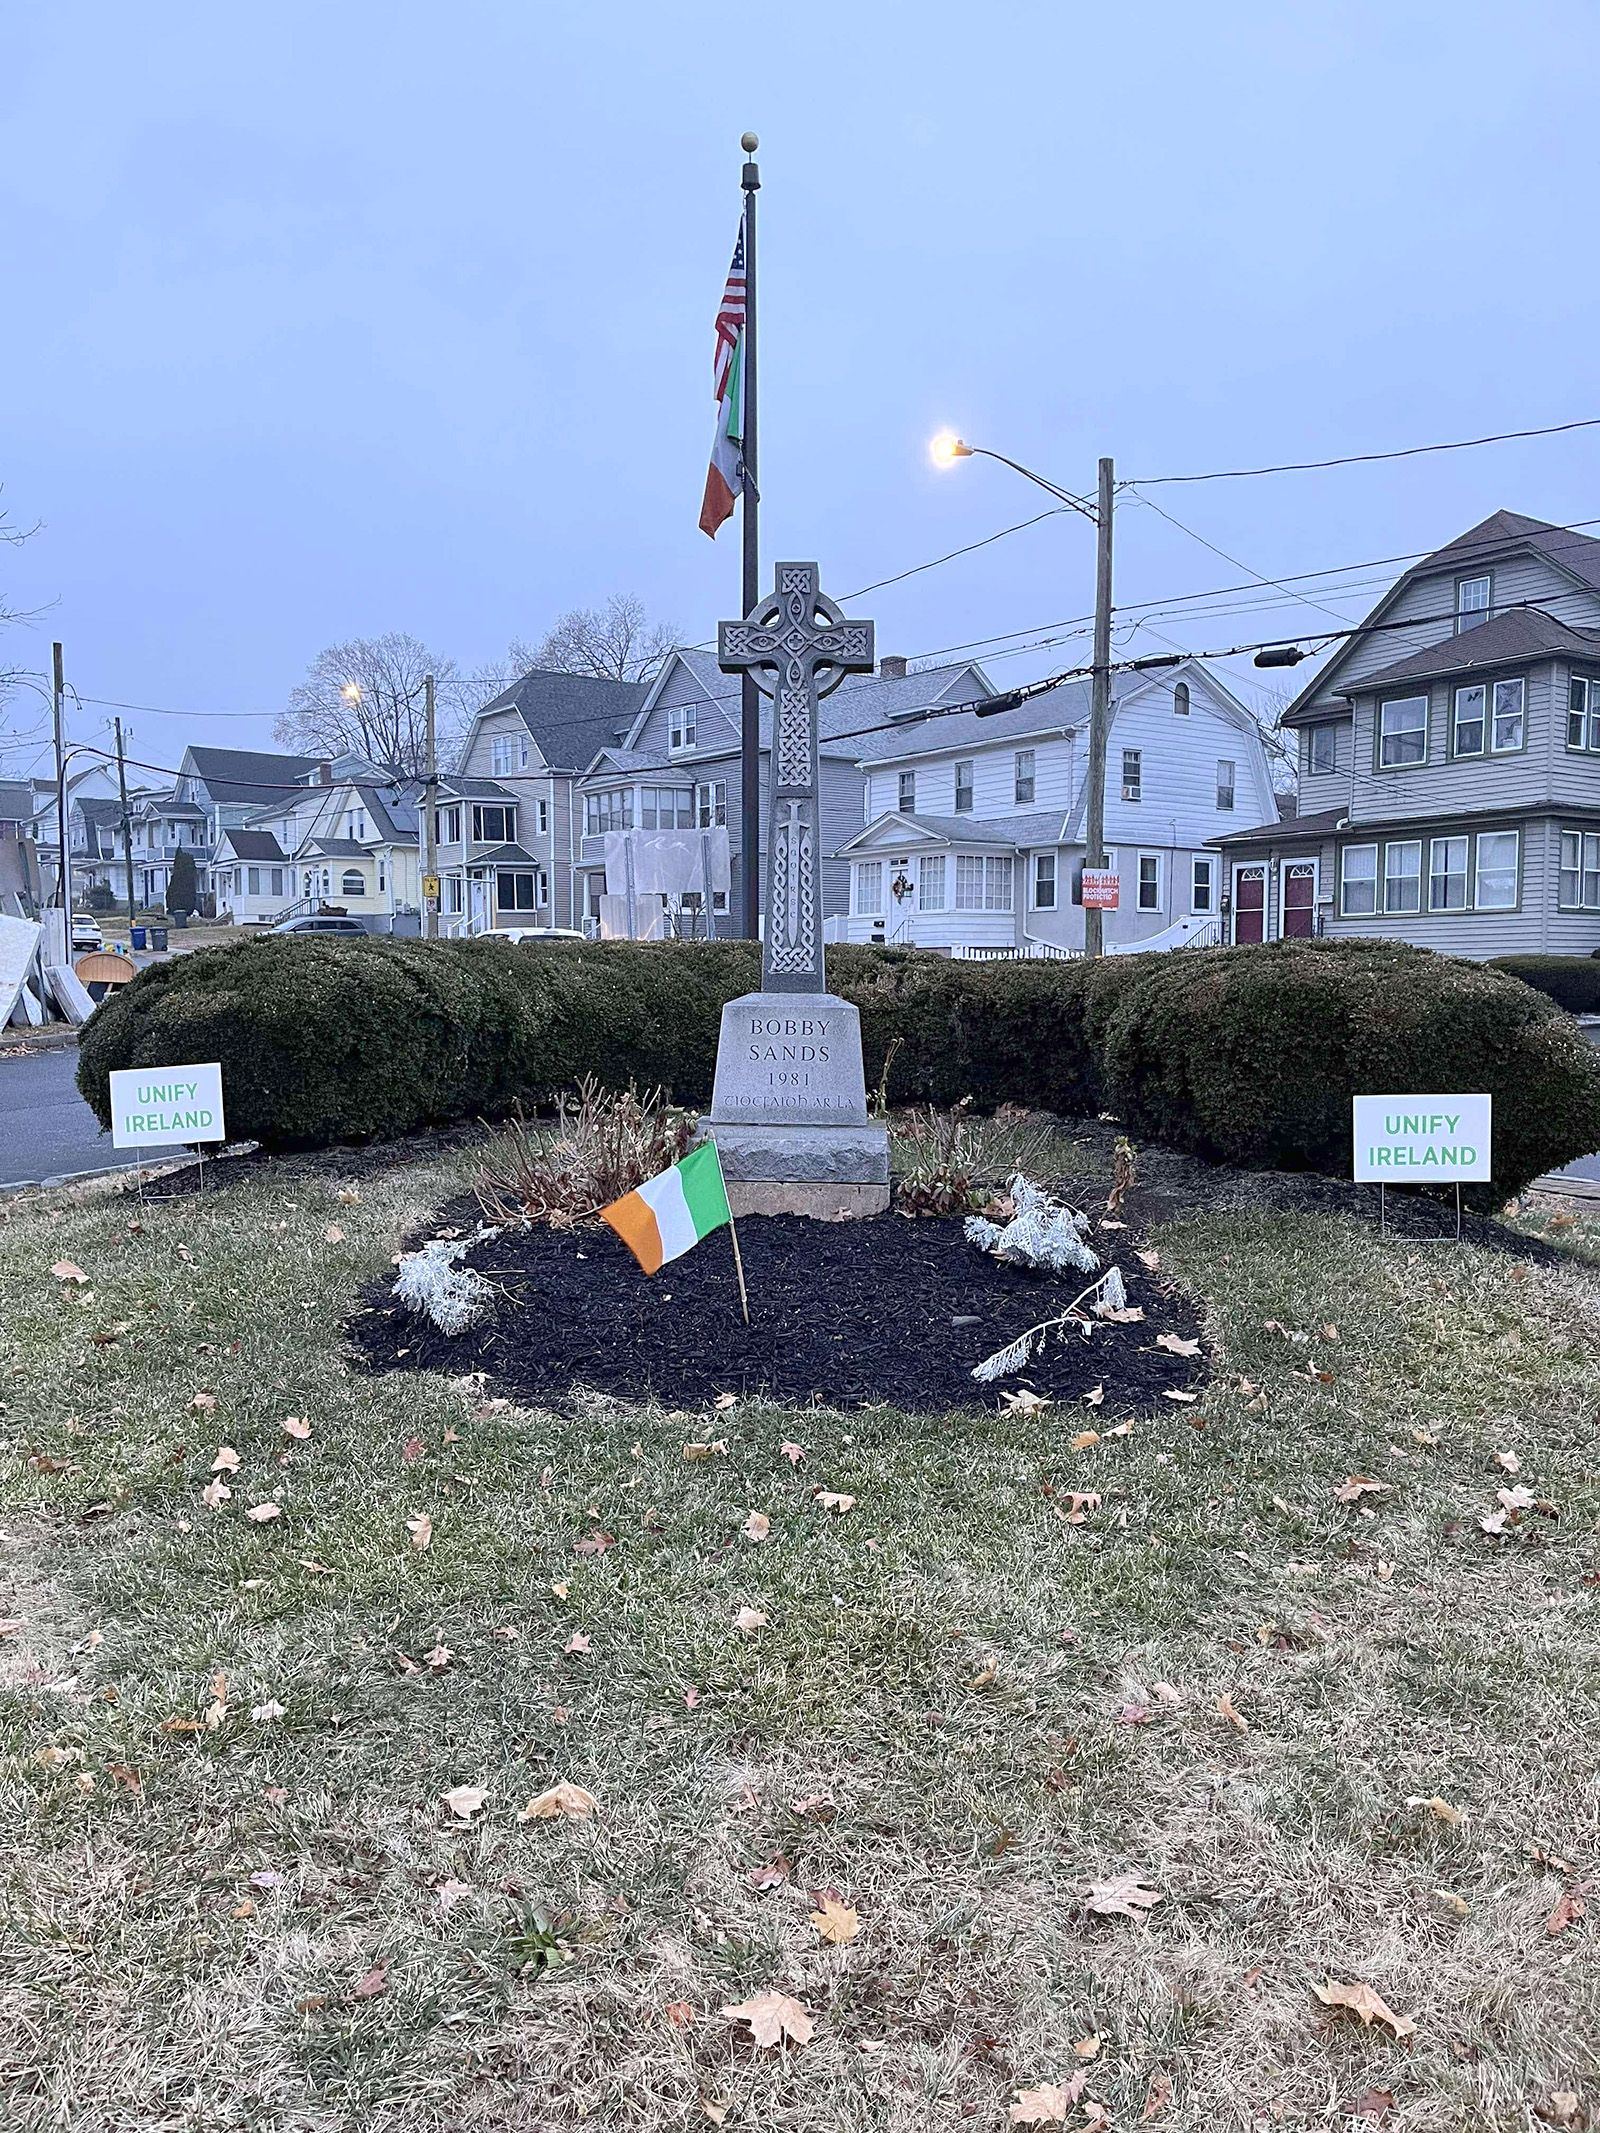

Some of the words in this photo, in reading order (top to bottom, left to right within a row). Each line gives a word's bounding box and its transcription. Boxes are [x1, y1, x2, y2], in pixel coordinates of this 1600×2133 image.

[751, 1019, 830, 1036] BOBBY
[749, 1045, 830, 1062] SANDS
[769, 1072, 809, 1086] 1981
[137, 1083, 197, 1104] UNIFY
[126, 1110, 213, 1132] IRELAND
[1385, 1115, 1460, 1134] UNIFY
[1369, 1147, 1477, 1165] IRELAND
